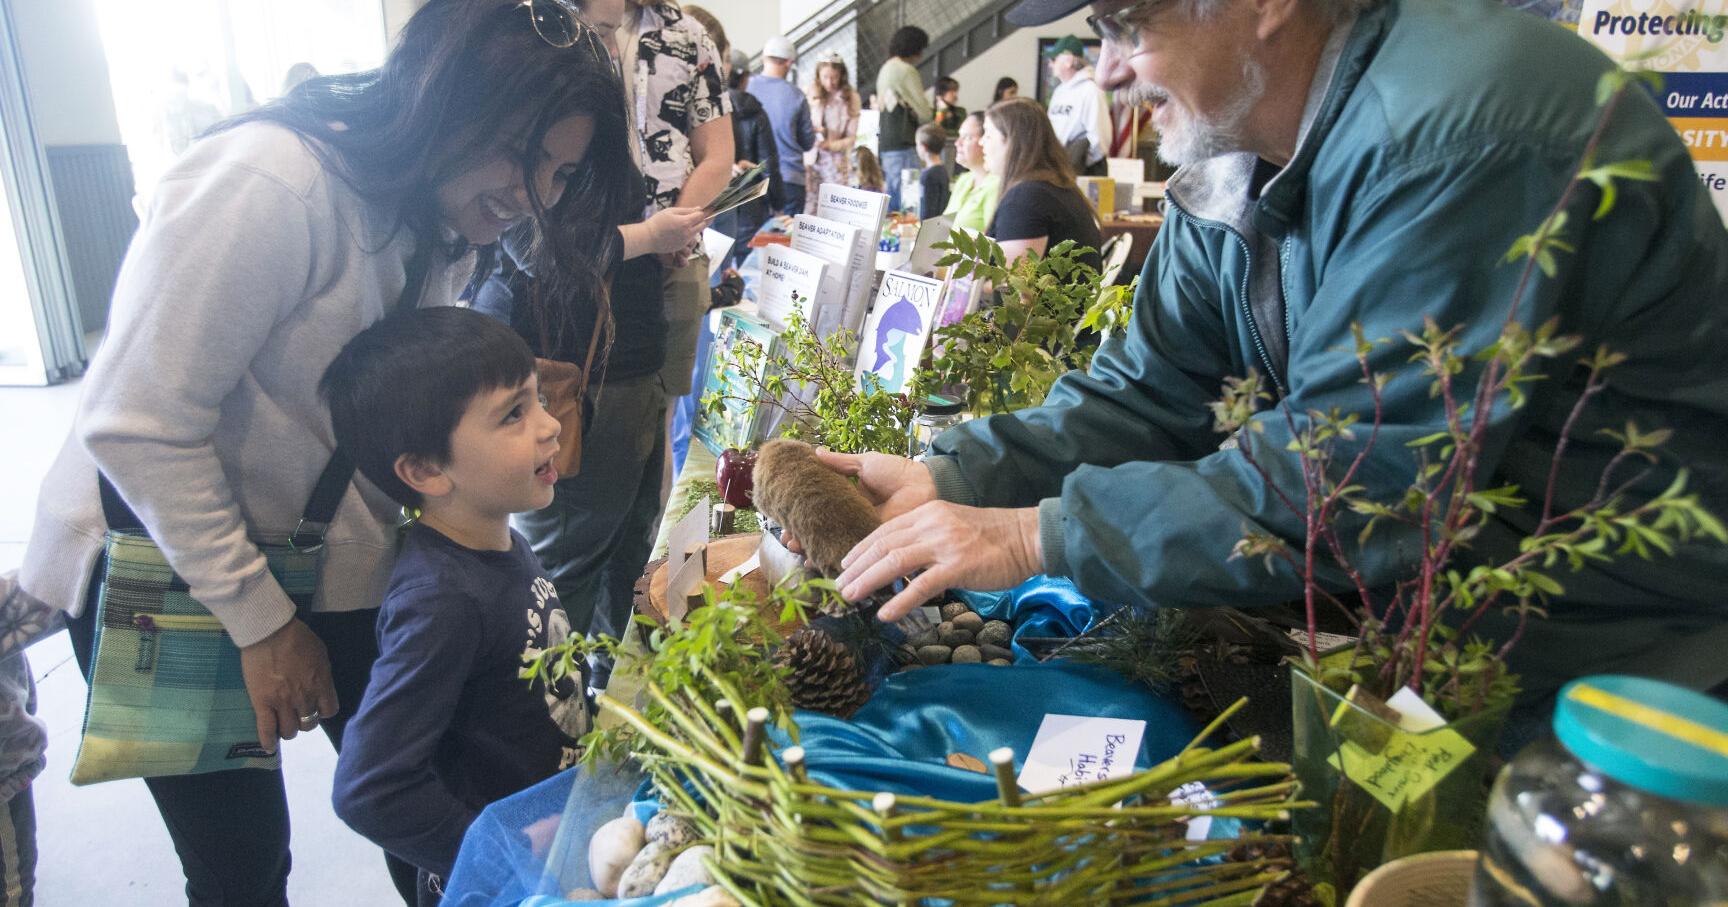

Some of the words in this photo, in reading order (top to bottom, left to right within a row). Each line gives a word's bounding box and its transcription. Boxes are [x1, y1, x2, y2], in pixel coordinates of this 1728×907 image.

[1593, 9, 1724, 43] Protecting
[1667, 92, 1699, 110] Our
[1678, 129, 1728, 148] SITY
[798, 221, 817, 232] BEAVER
[882, 277, 935, 308] SALMON
[1074, 753, 1097, 788] Habi
[1097, 734, 1125, 780] Beavers
